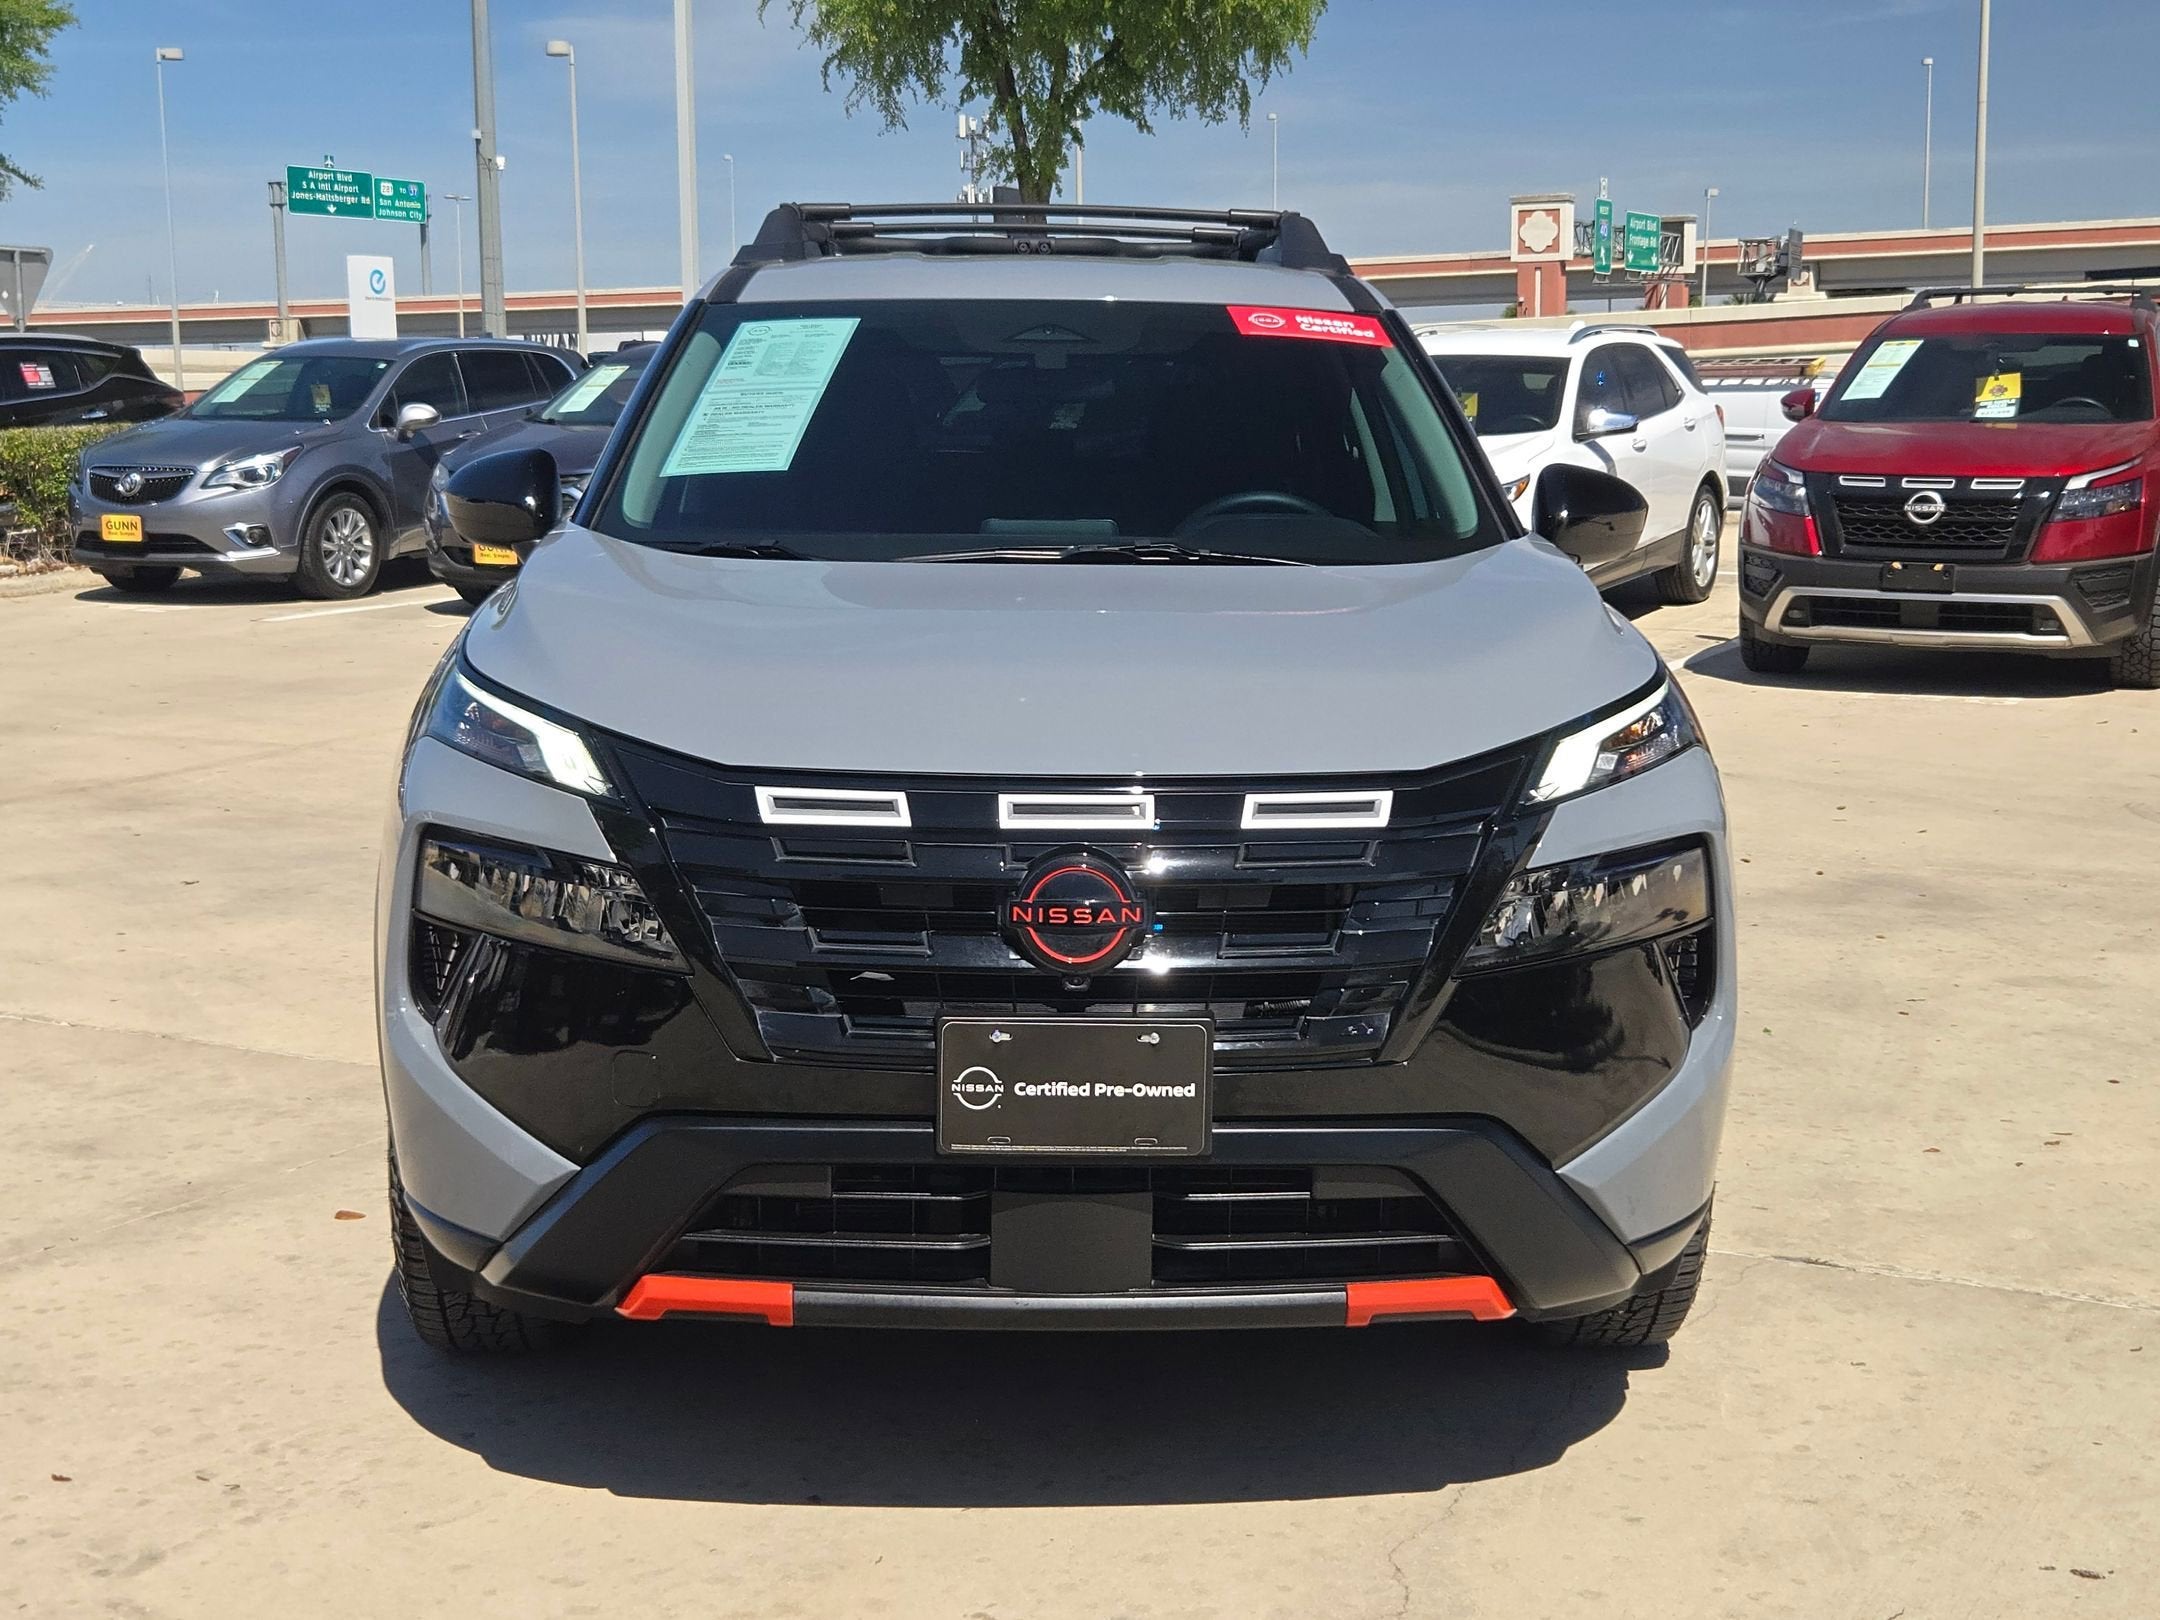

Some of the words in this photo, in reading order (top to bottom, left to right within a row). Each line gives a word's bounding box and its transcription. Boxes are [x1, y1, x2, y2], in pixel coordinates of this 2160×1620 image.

[308, 170, 334, 181] Airport
[336, 173, 353, 182] Blvd
[302, 180, 307, 189] S
[310, 181, 316, 190] A
[333, 184, 359, 193] Airport
[379, 198, 392, 207] San
[395, 199, 421, 209] Antonio
[379, 208, 407, 218] Johnson
[409, 211, 423, 221] City
[1629, 218, 1646, 231] Airport
[1295, 315, 1355, 329] Nissan
[1300, 322, 1376, 338] Certified
[105, 520, 138, 530] GUNN
[1012, 906, 1142, 924] NISSAN
[951, 1082, 1004, 1094] NISSAN
[1013, 1081, 1090, 1098] Certified
[1094, 1083, 1196, 1099] Pre-Owned
